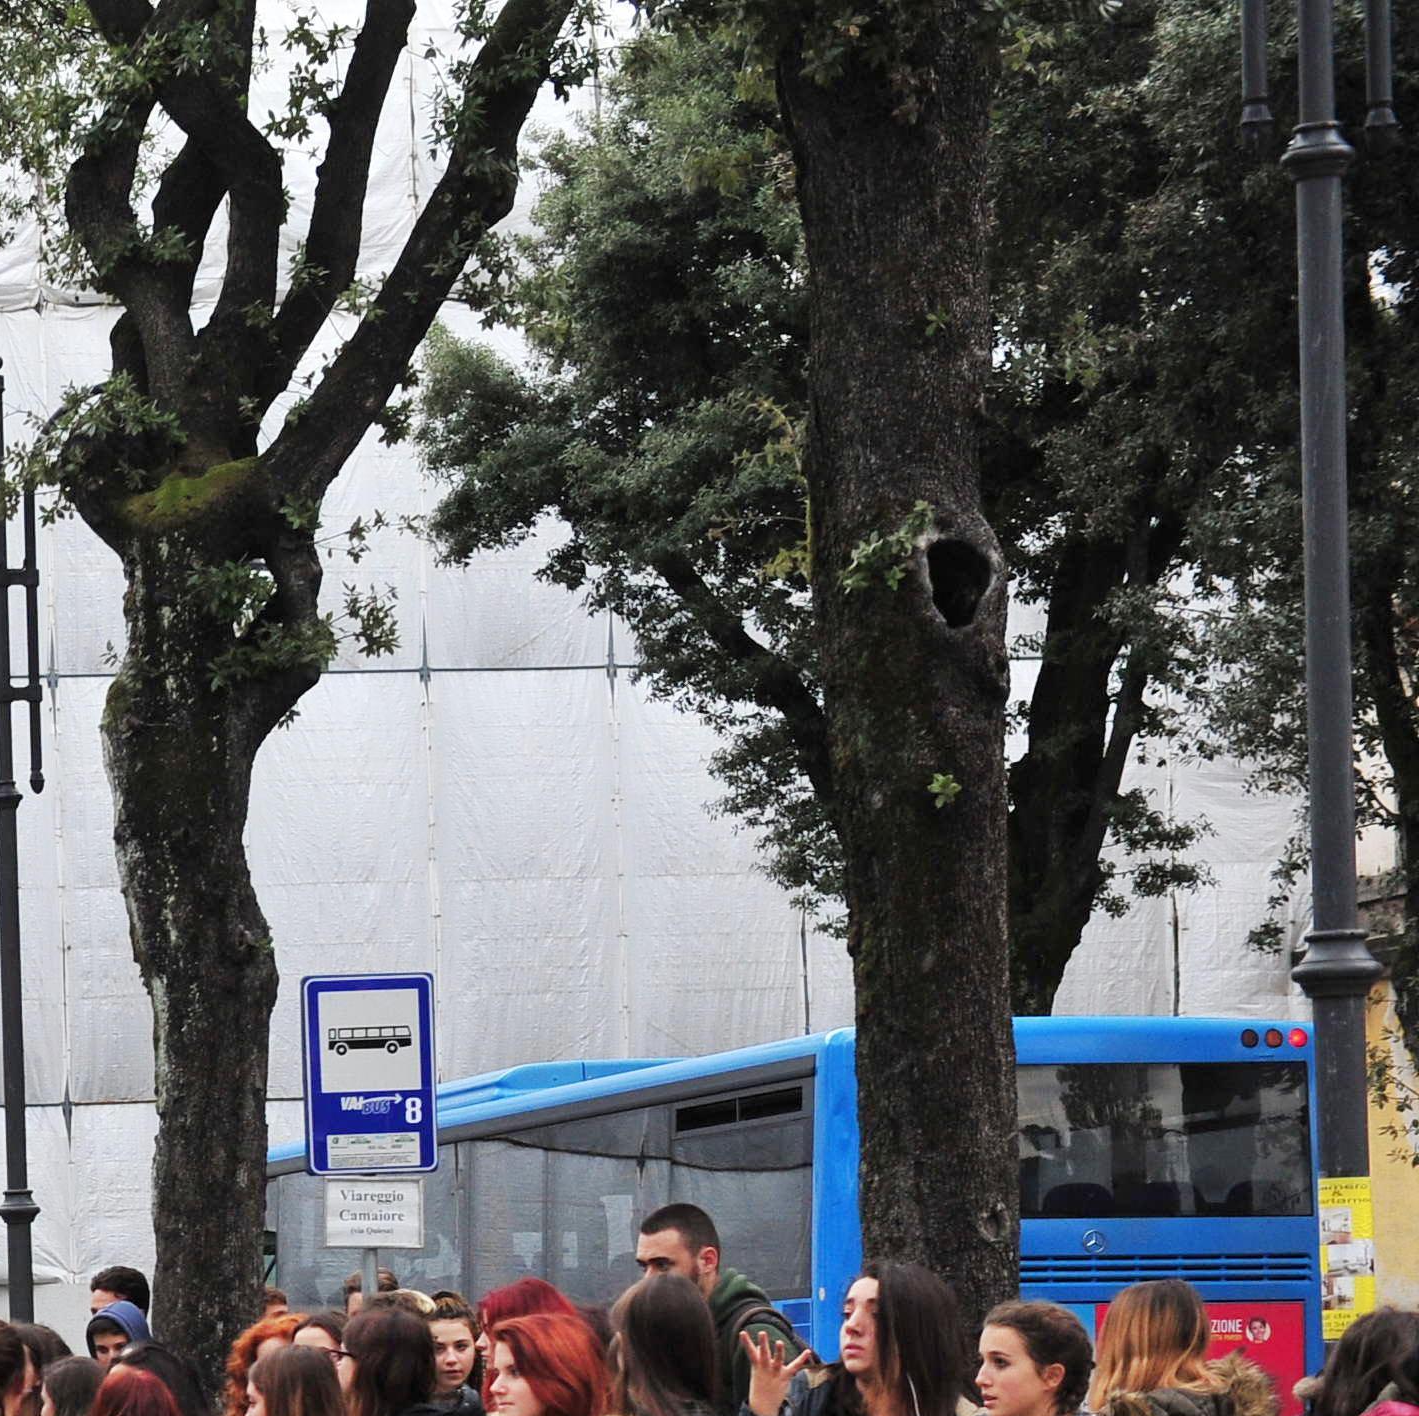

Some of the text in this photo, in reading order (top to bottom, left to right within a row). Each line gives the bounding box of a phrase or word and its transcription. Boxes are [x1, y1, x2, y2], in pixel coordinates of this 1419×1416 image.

[405, 1097, 423, 1124] 8
[340, 1190, 404, 1204] Viareggio
[339, 1209, 405, 1222] Camaiore
